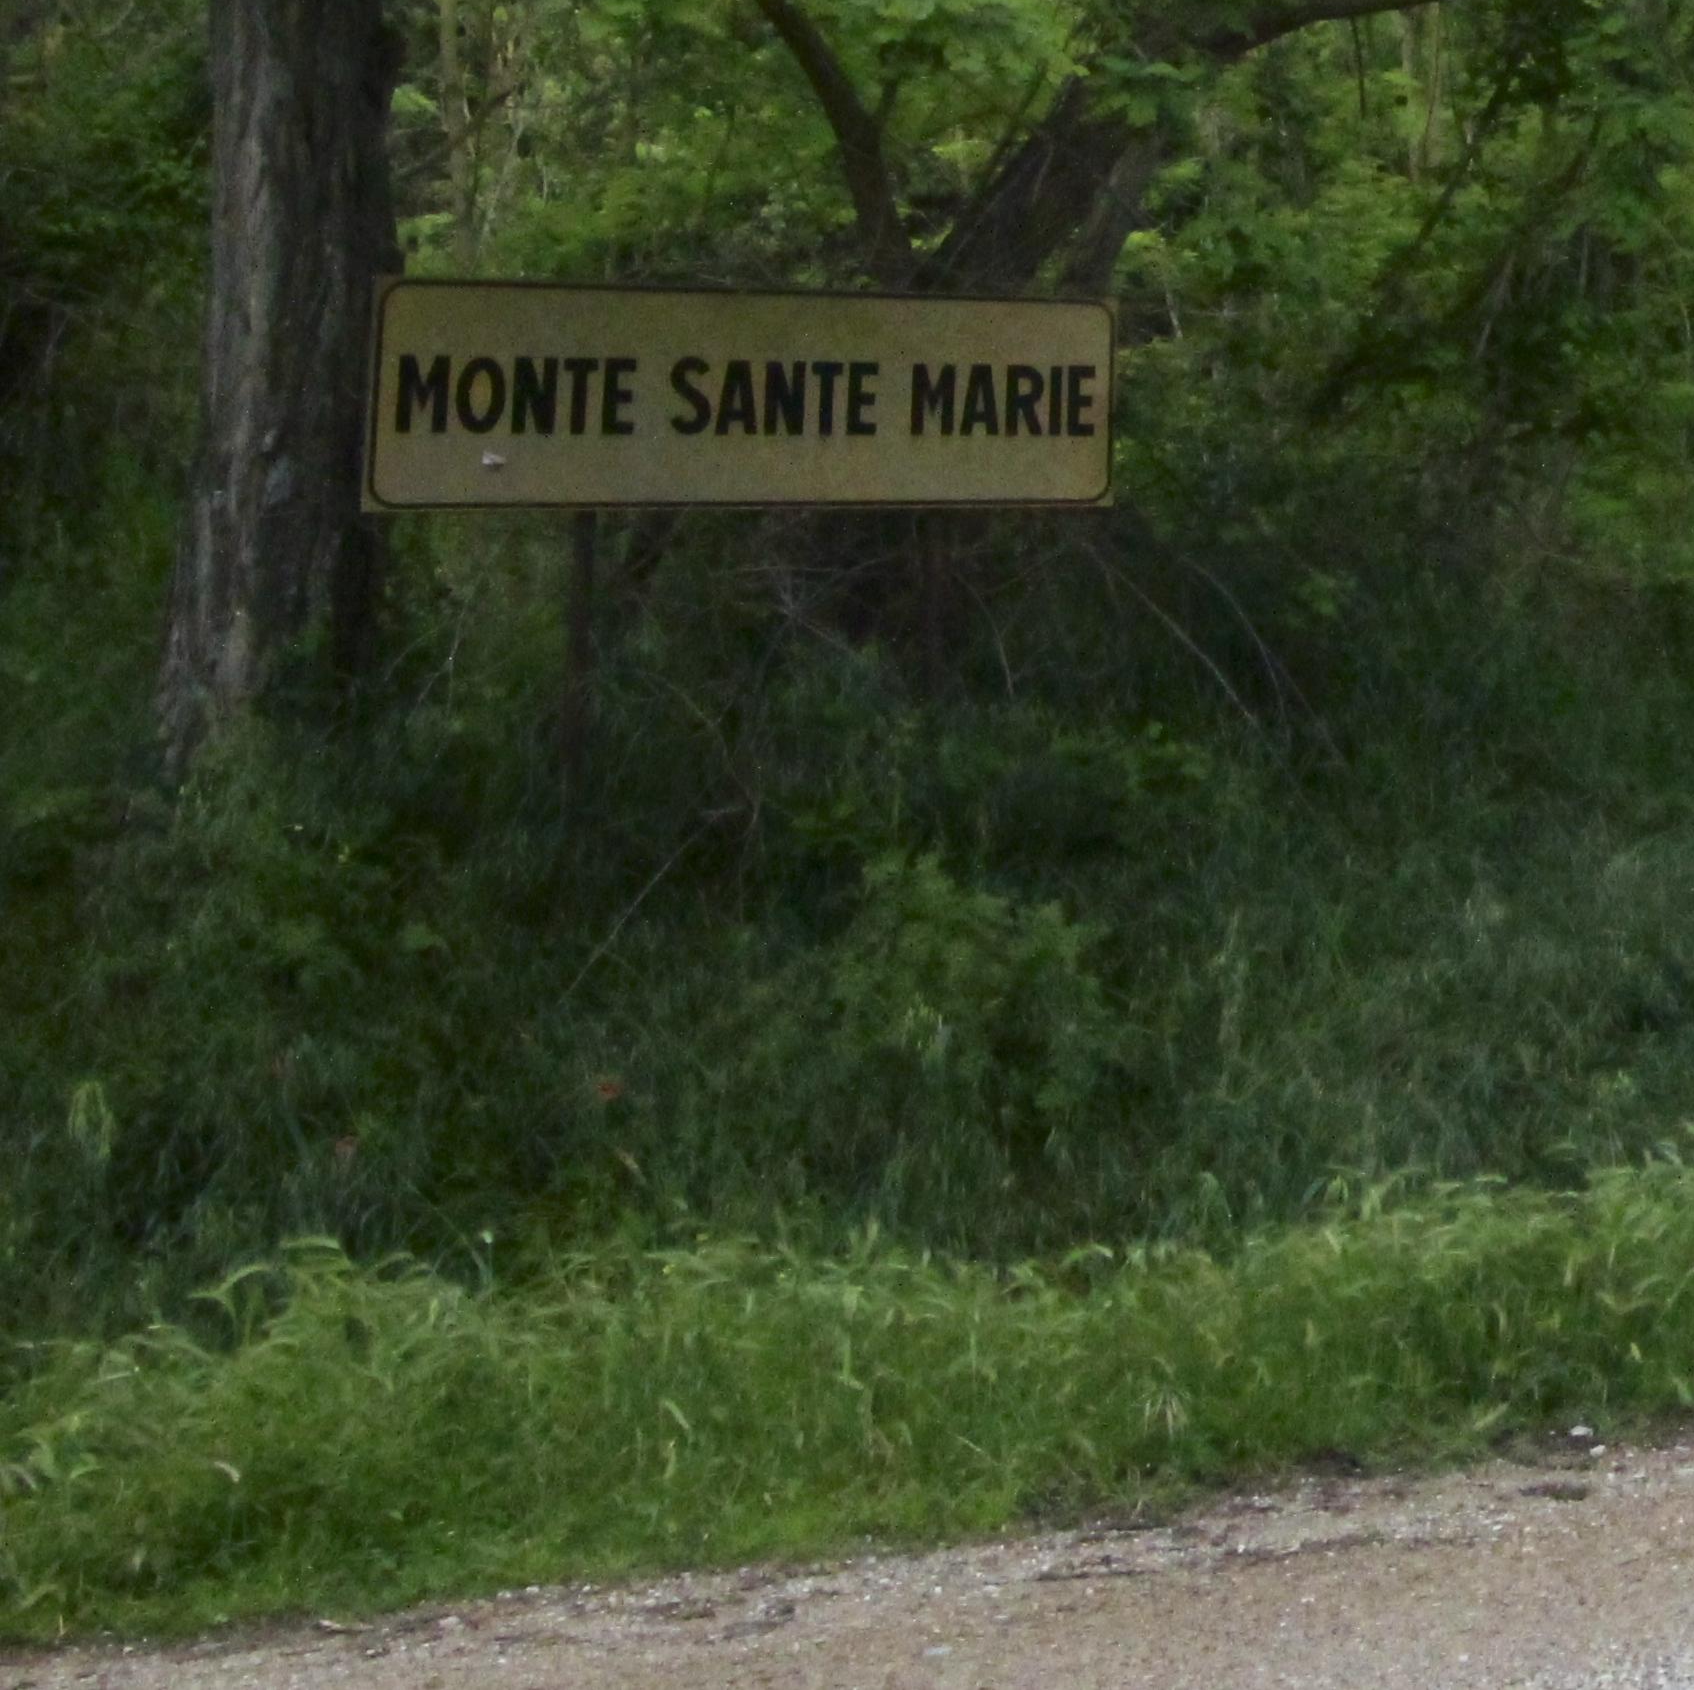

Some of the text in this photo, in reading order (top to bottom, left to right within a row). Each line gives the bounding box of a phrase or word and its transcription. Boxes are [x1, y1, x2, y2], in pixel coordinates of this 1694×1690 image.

[395, 353, 1096, 437] MONTE SANTE MARIE
